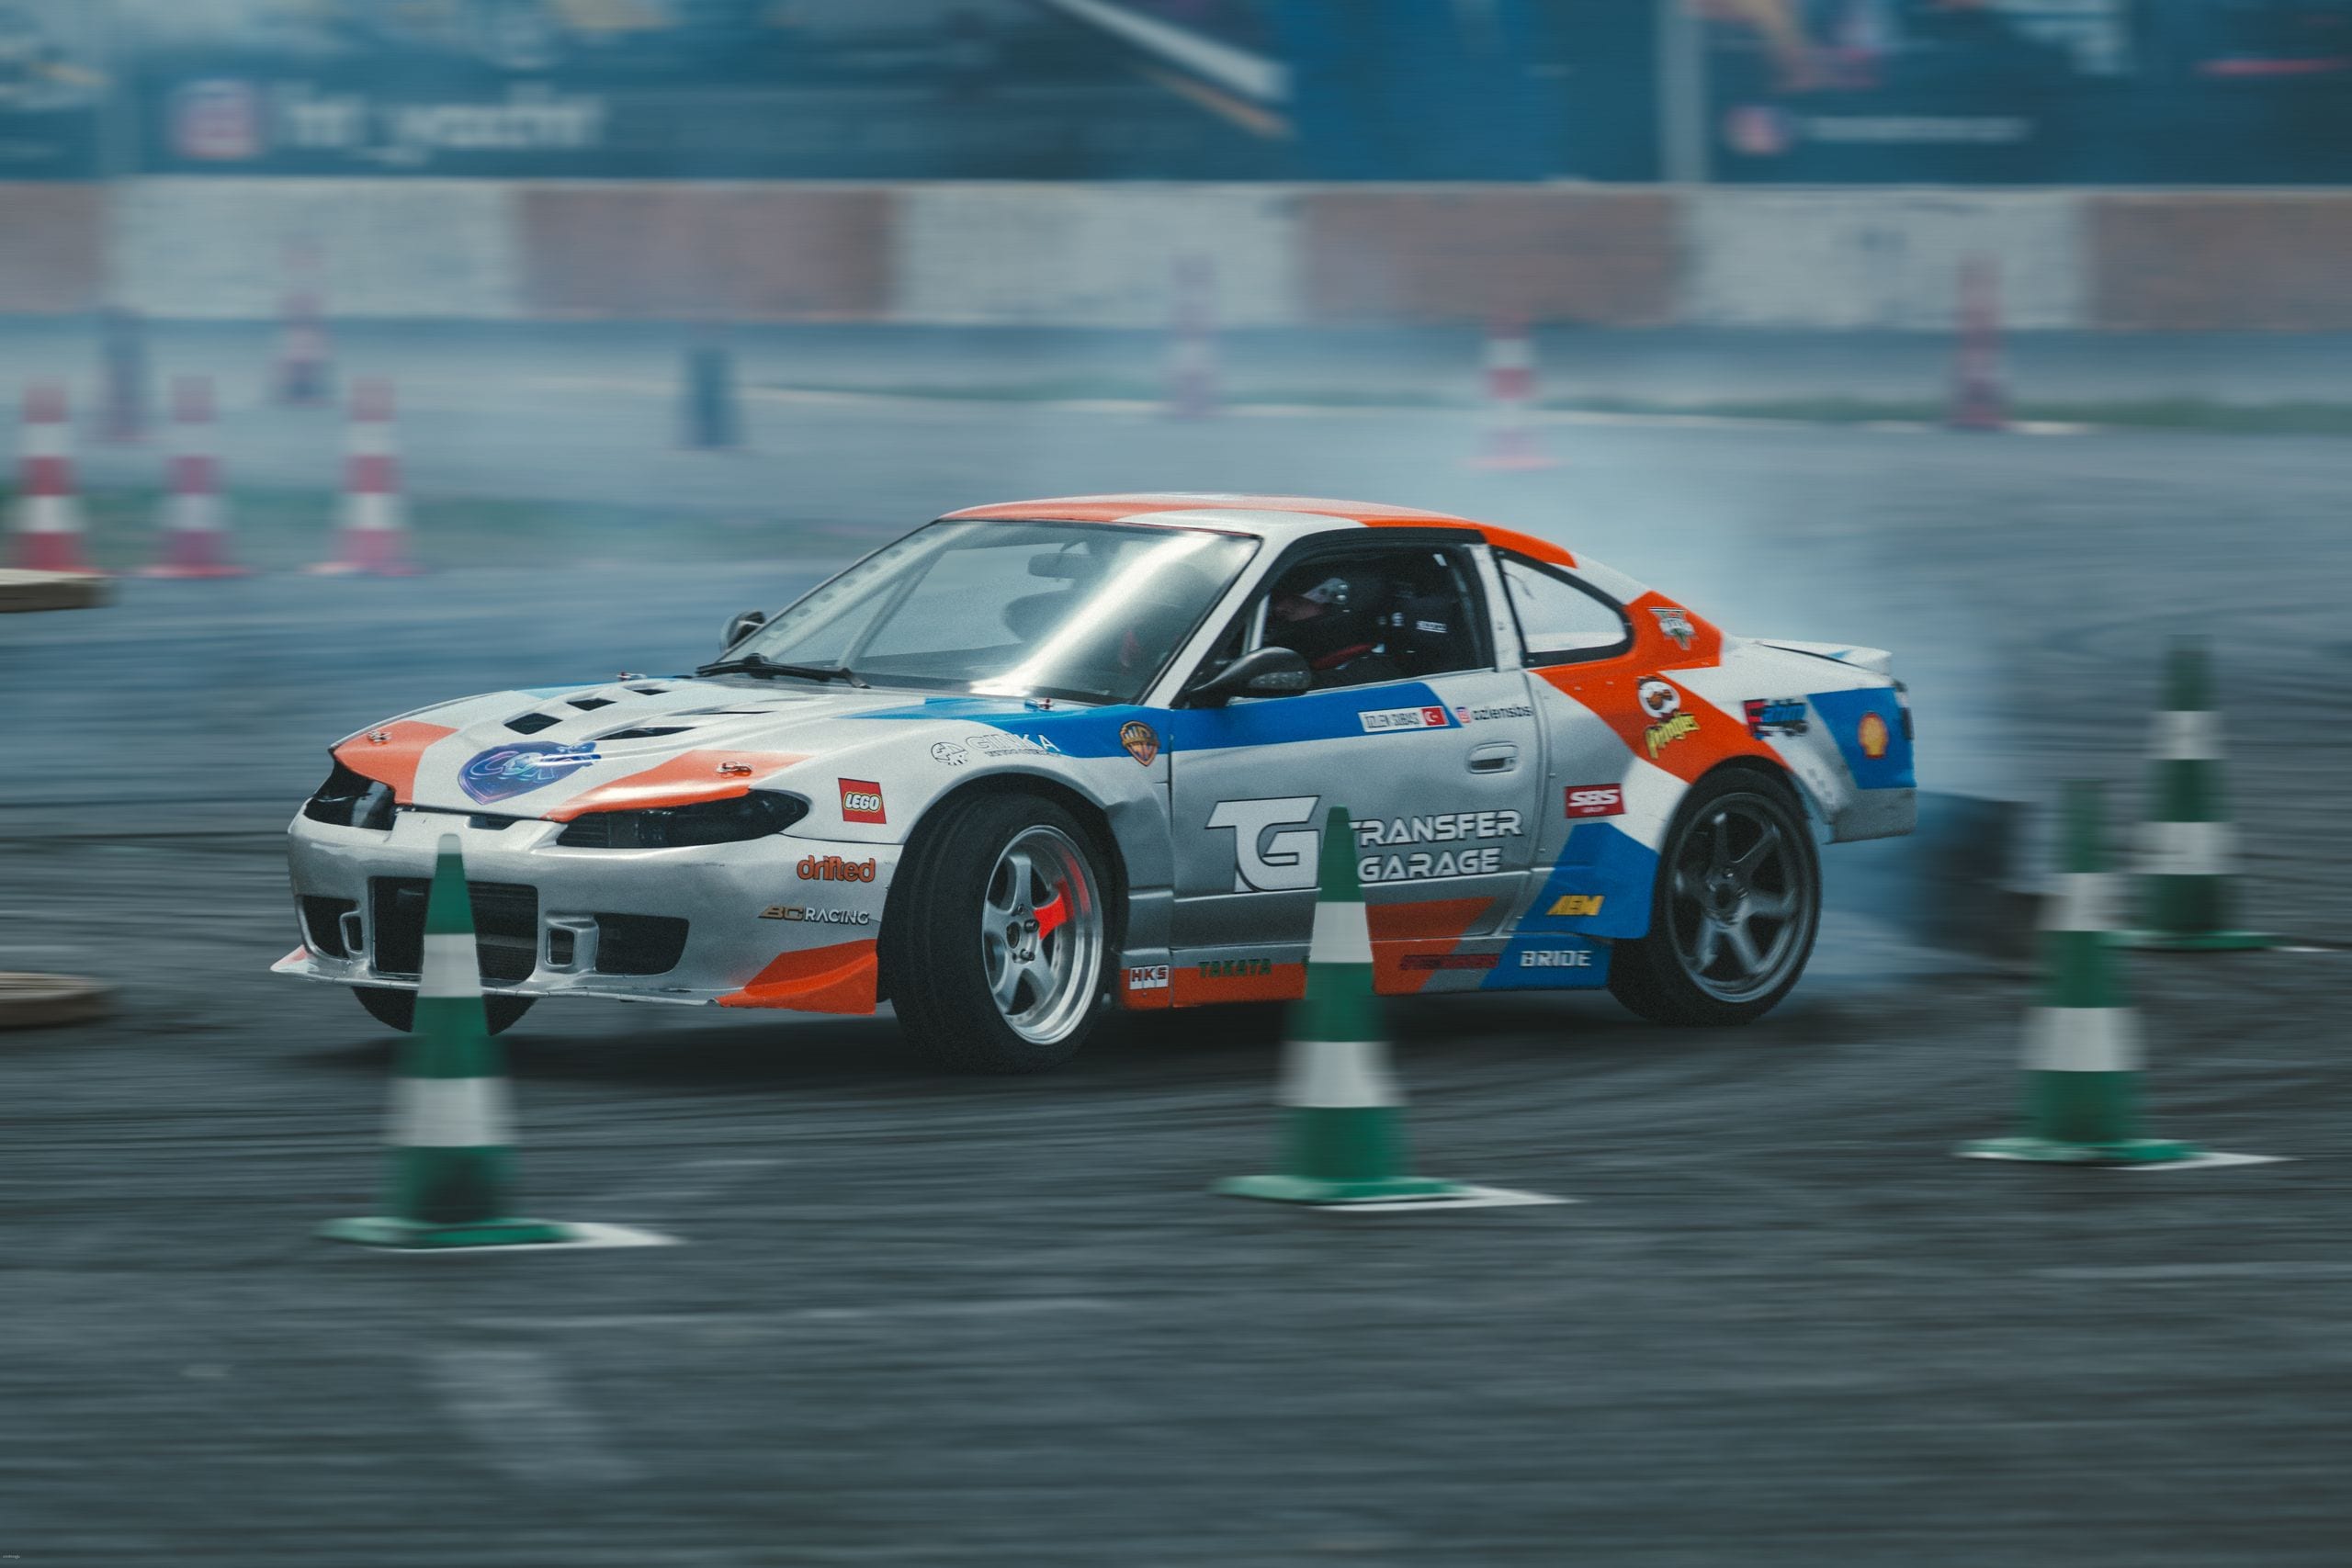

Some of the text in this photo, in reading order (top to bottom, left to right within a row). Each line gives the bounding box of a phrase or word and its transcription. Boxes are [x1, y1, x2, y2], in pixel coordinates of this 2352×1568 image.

[965, 733, 1061, 752] GINKA
[843, 792, 882, 812] LEGO
[1568, 789, 1619, 807] SBS
[1348, 809, 1524, 848] RANSFER
[1204, 795, 1321, 893] TG
[797, 854, 876, 883] drifted
[1357, 847, 1504, 883] GARAGE
[804, 907, 870, 926] RACING
[1198, 958, 1272, 978] TAKATA
[1520, 950, 1592, 967] BRIDE
[1131, 966, 1168, 982] HKS
